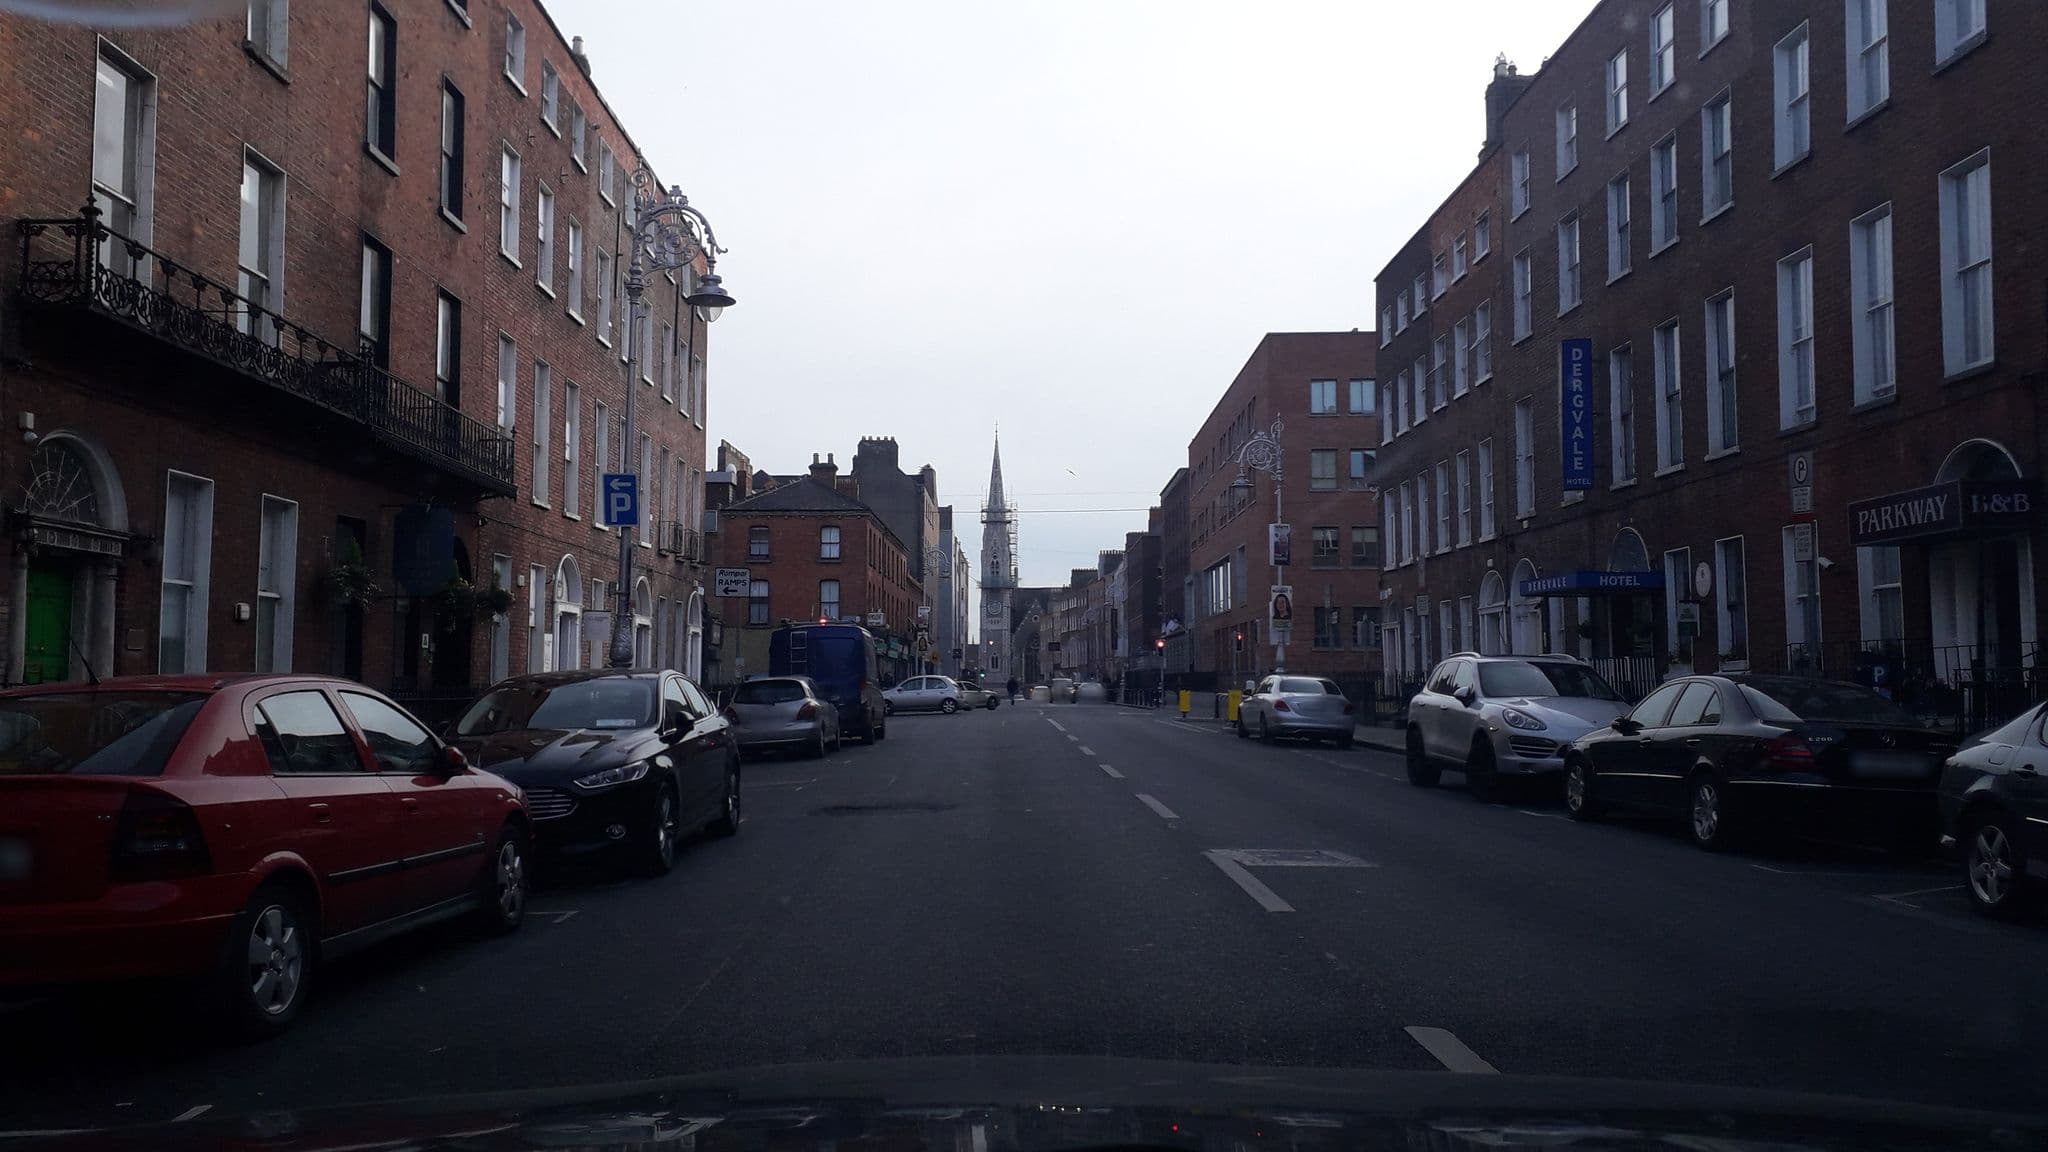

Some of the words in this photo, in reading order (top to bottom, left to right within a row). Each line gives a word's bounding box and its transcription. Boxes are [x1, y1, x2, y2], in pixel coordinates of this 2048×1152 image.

[1571, 348, 1585, 470] DERGVALE
[1566, 478, 1592, 486] HOTEL
[610, 492, 632, 523] P
[1856, 493, 1948, 535] PARKWAY
[1971, 493, 2031, 513] B&B
[718, 578, 748, 587] RAMPS
[1527, 575, 1568, 592] DERGVALE
[1599, 575, 1641, 587] HOTEL
[1873, 666, 1885, 683] P
